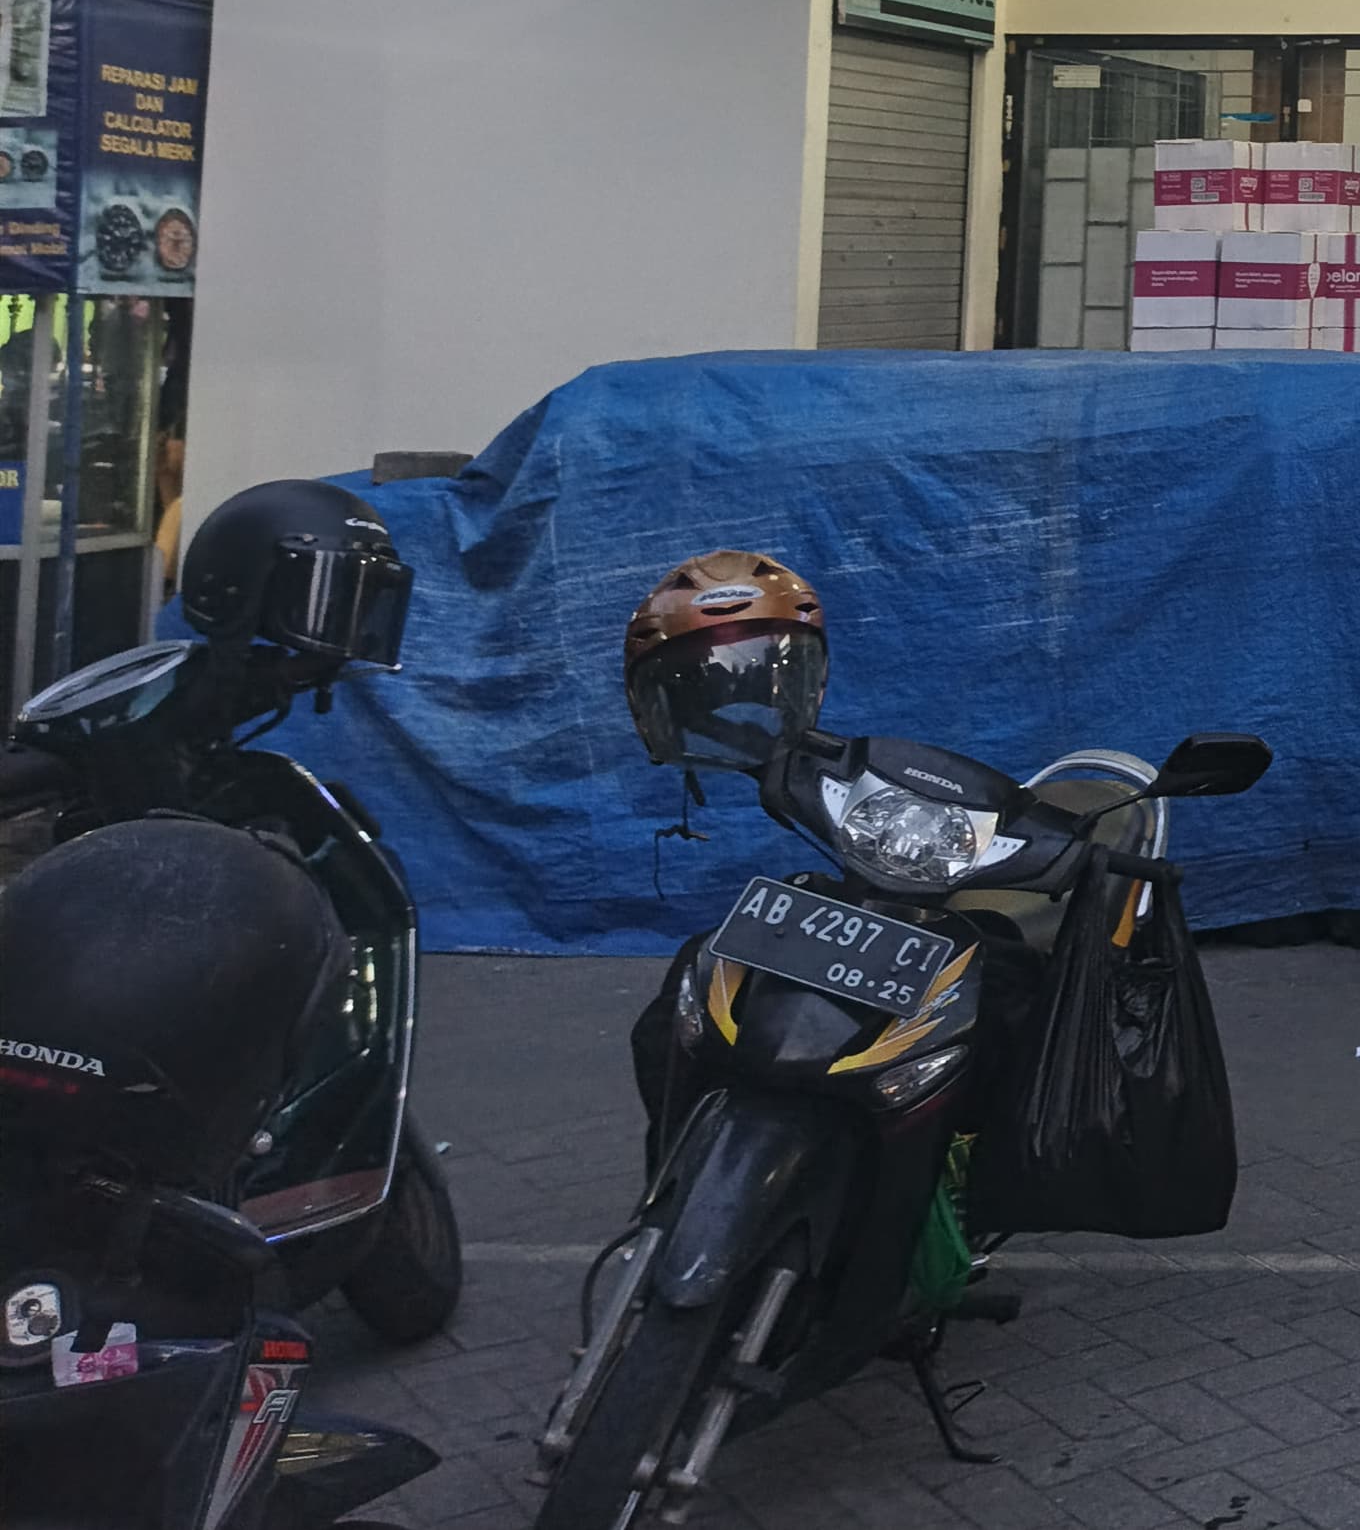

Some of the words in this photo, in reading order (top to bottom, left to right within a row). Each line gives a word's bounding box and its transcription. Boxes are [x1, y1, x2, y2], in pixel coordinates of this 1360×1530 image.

[101, 64, 166, 91] REPARASI
[168, 77, 198, 95] JAM
[135, 93, 164, 113] DAN
[103, 111, 192, 139] CALCULATOR
[100, 133, 154, 157] SEGALA
[904, 766, 965, 795] HONDA
[741, 887, 794, 926] AB
[799, 906, 884, 954] 4297
[0, 1038, 106, 1078] HONDA
